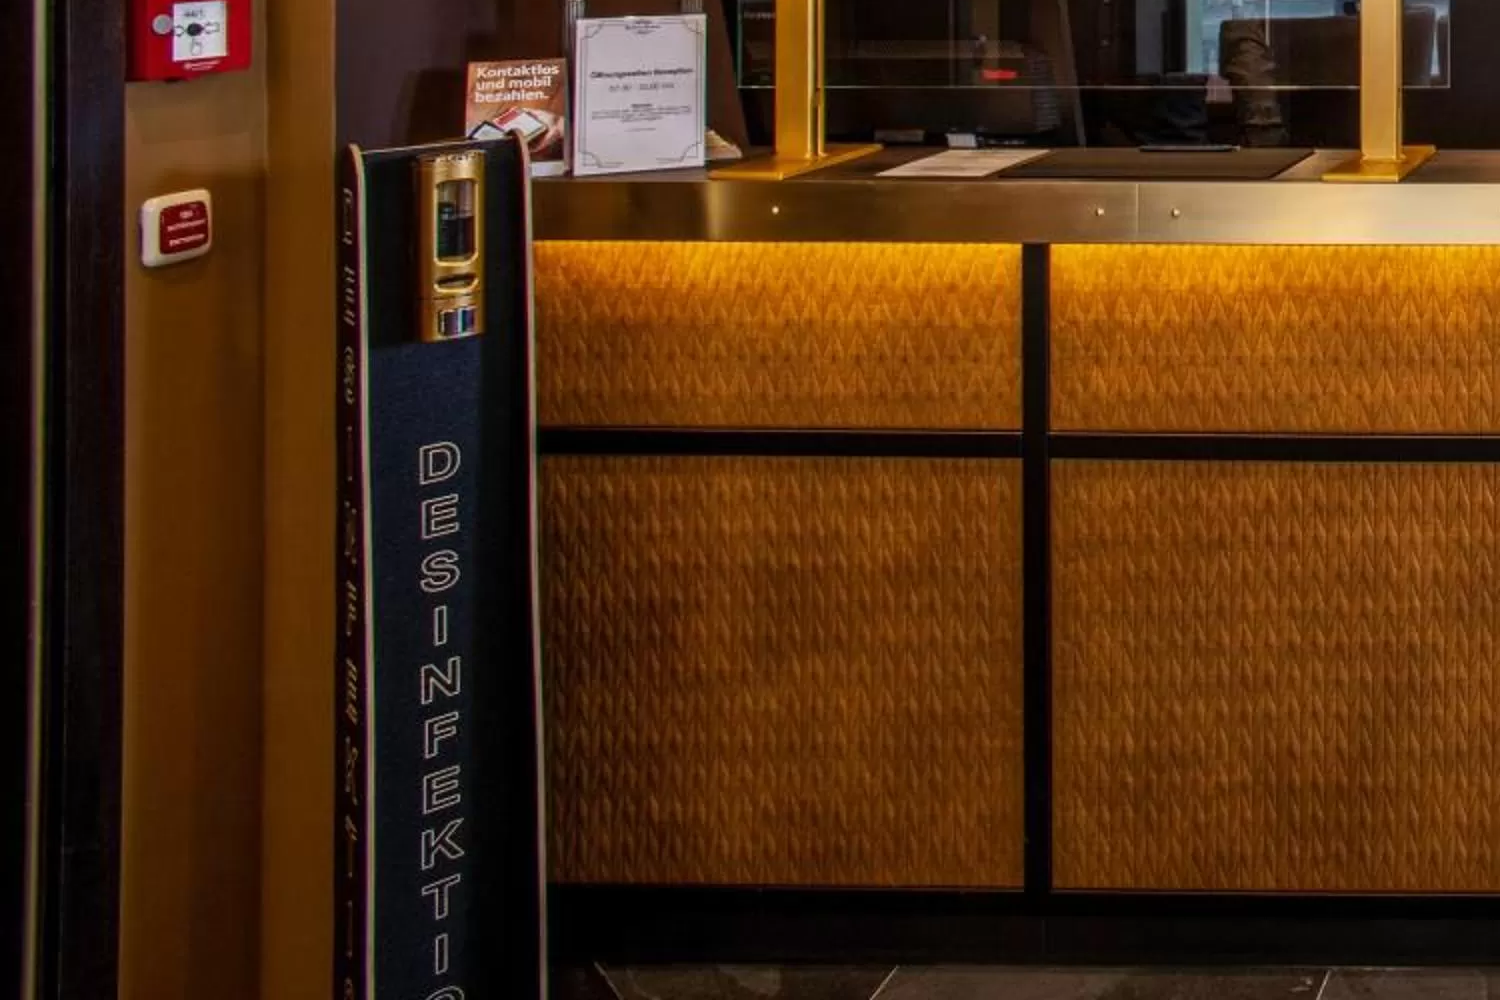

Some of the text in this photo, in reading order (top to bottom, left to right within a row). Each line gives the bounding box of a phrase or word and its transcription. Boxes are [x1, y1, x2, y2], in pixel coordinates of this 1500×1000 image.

[476, 64, 560, 79] Kontaktlos
[475, 76, 551, 91] und mobil
